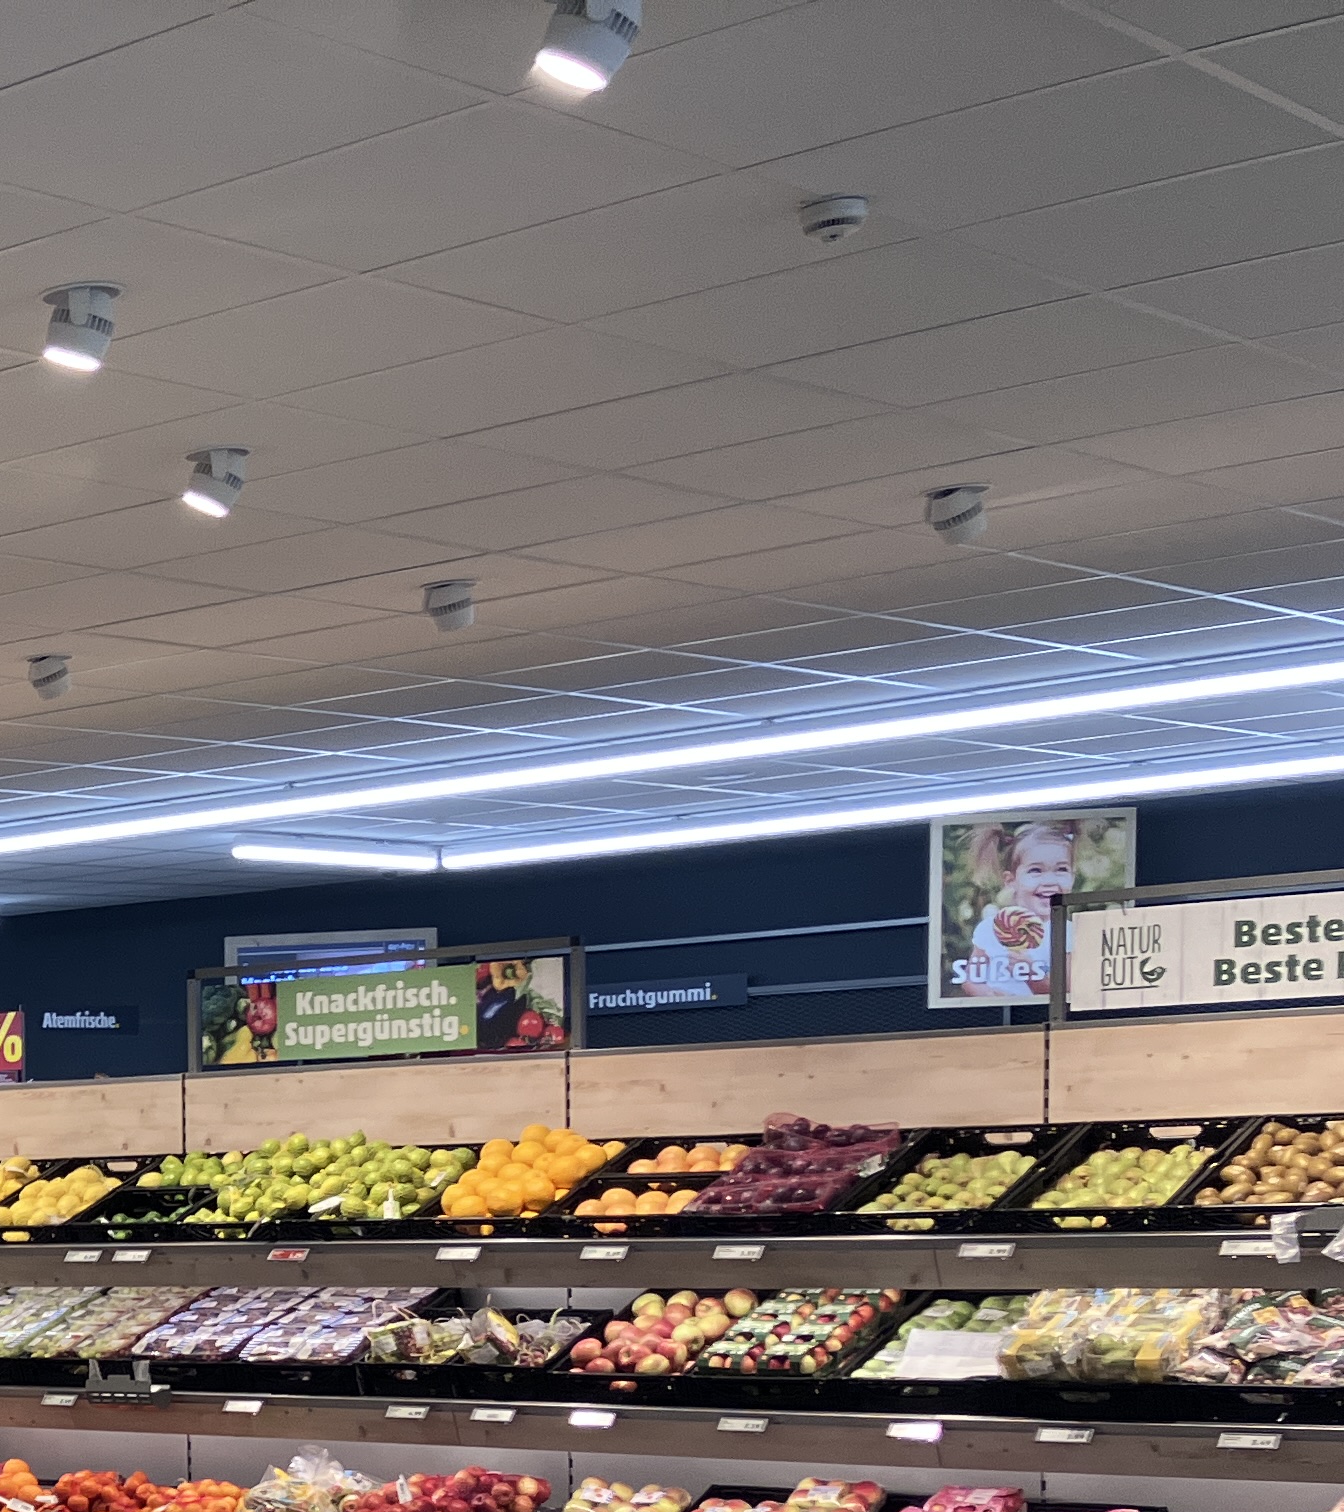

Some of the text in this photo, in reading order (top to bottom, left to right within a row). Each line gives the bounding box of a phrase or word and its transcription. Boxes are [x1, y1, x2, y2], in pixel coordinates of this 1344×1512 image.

[1101, 924, 1162, 956] NATUR
[1233, 916, 1344, 948] Beste
[951, 958, 1048, 985] Süßes
[1100, 957, 1136, 987] GUT
[1213, 954, 1325, 987] Beste
[295, 980, 457, 1016] Knackfrisch.
[588, 982, 719, 1009] Fruchtgummi.
[42, 1010, 120, 1029] Atemfrische.
[284, 1007, 469, 1050] Supergünstig.
